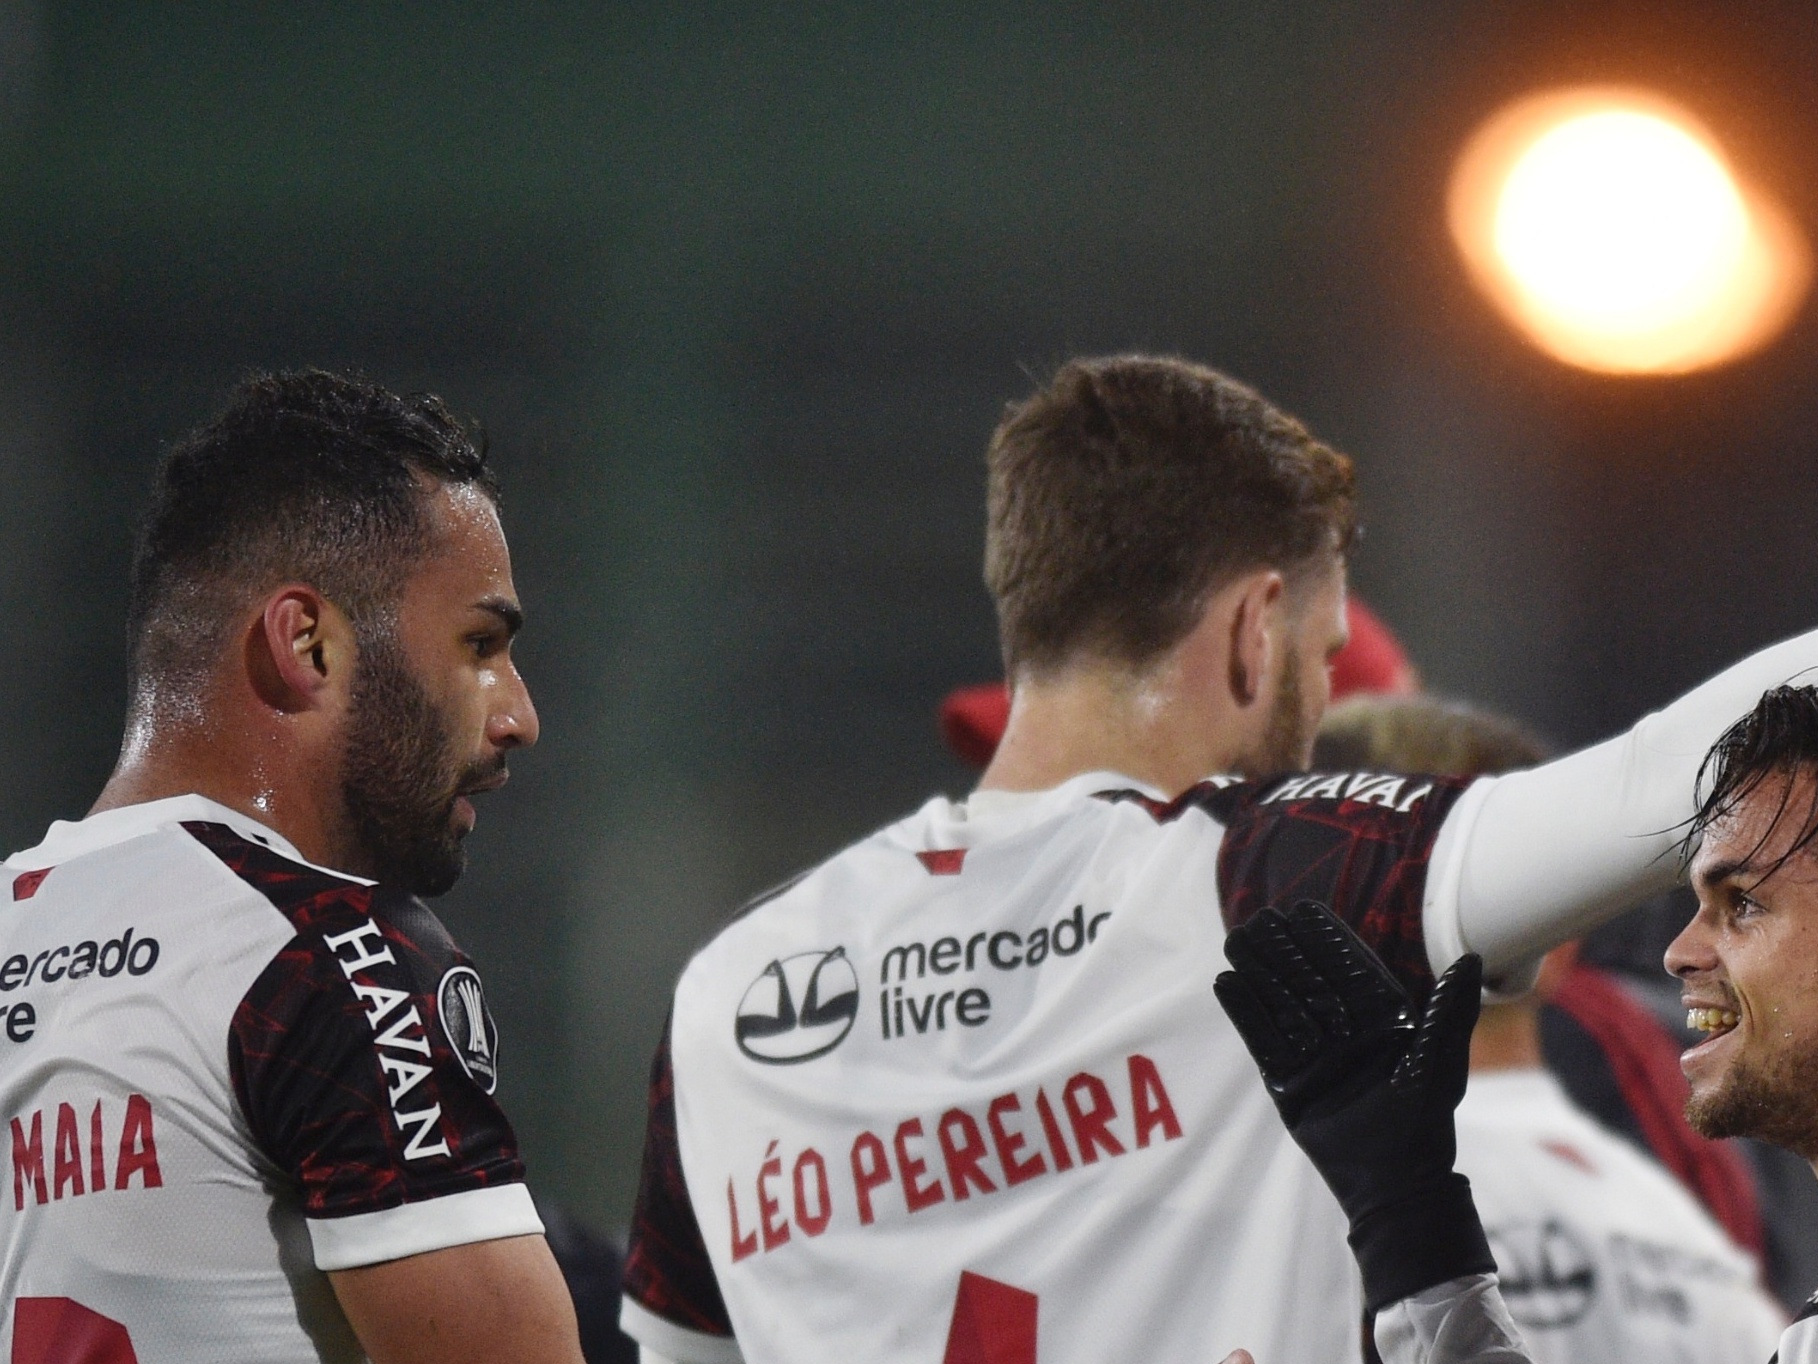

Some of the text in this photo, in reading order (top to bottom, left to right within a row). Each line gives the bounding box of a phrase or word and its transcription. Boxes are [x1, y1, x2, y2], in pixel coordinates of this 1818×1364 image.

[323, 917, 452, 1162] HAVAN
[880, 982, 993, 1041] livre
[10, 1093, 164, 1213] MAIA
[726, 1053, 1184, 1264] LÉO PEREIRA
